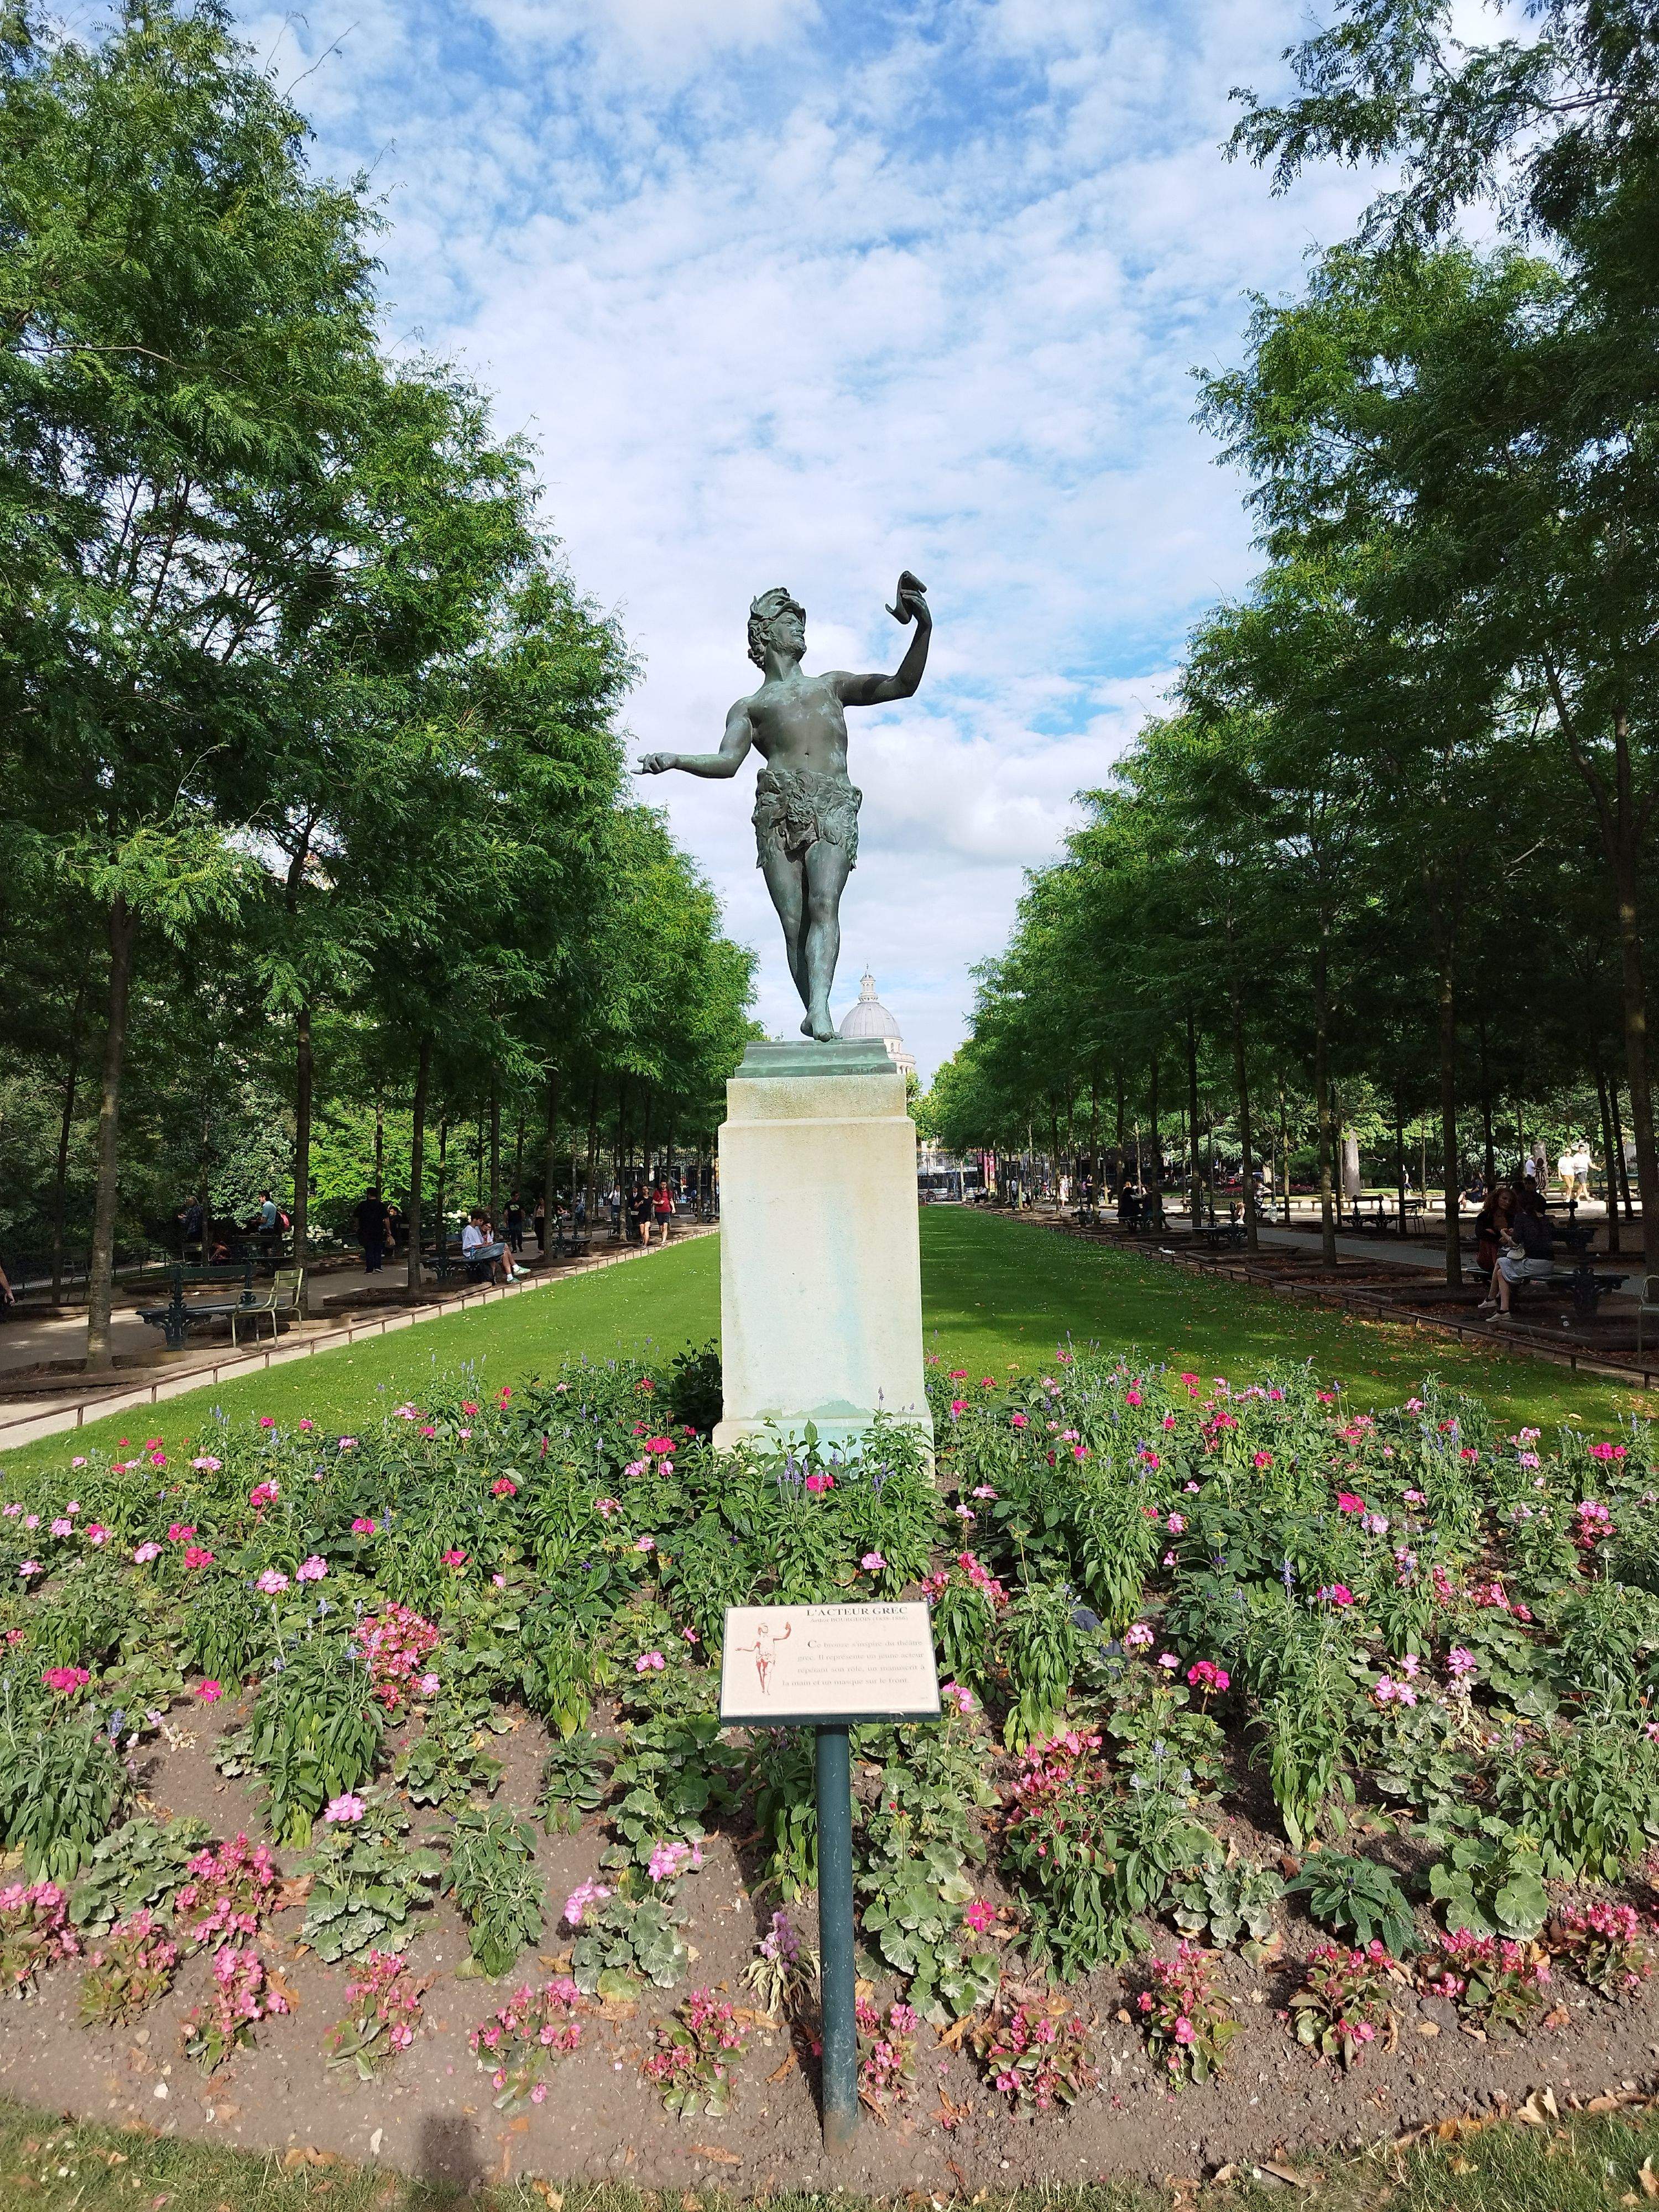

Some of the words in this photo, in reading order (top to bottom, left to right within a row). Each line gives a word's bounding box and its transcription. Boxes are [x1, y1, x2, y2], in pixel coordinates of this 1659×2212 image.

[807, 1608, 869, 1616] L'ACTEUR
[872, 1606, 907, 1615] GREC
[807, 1640, 821, 1648] Ce
[852, 1641, 883, 1649] s'inspire
